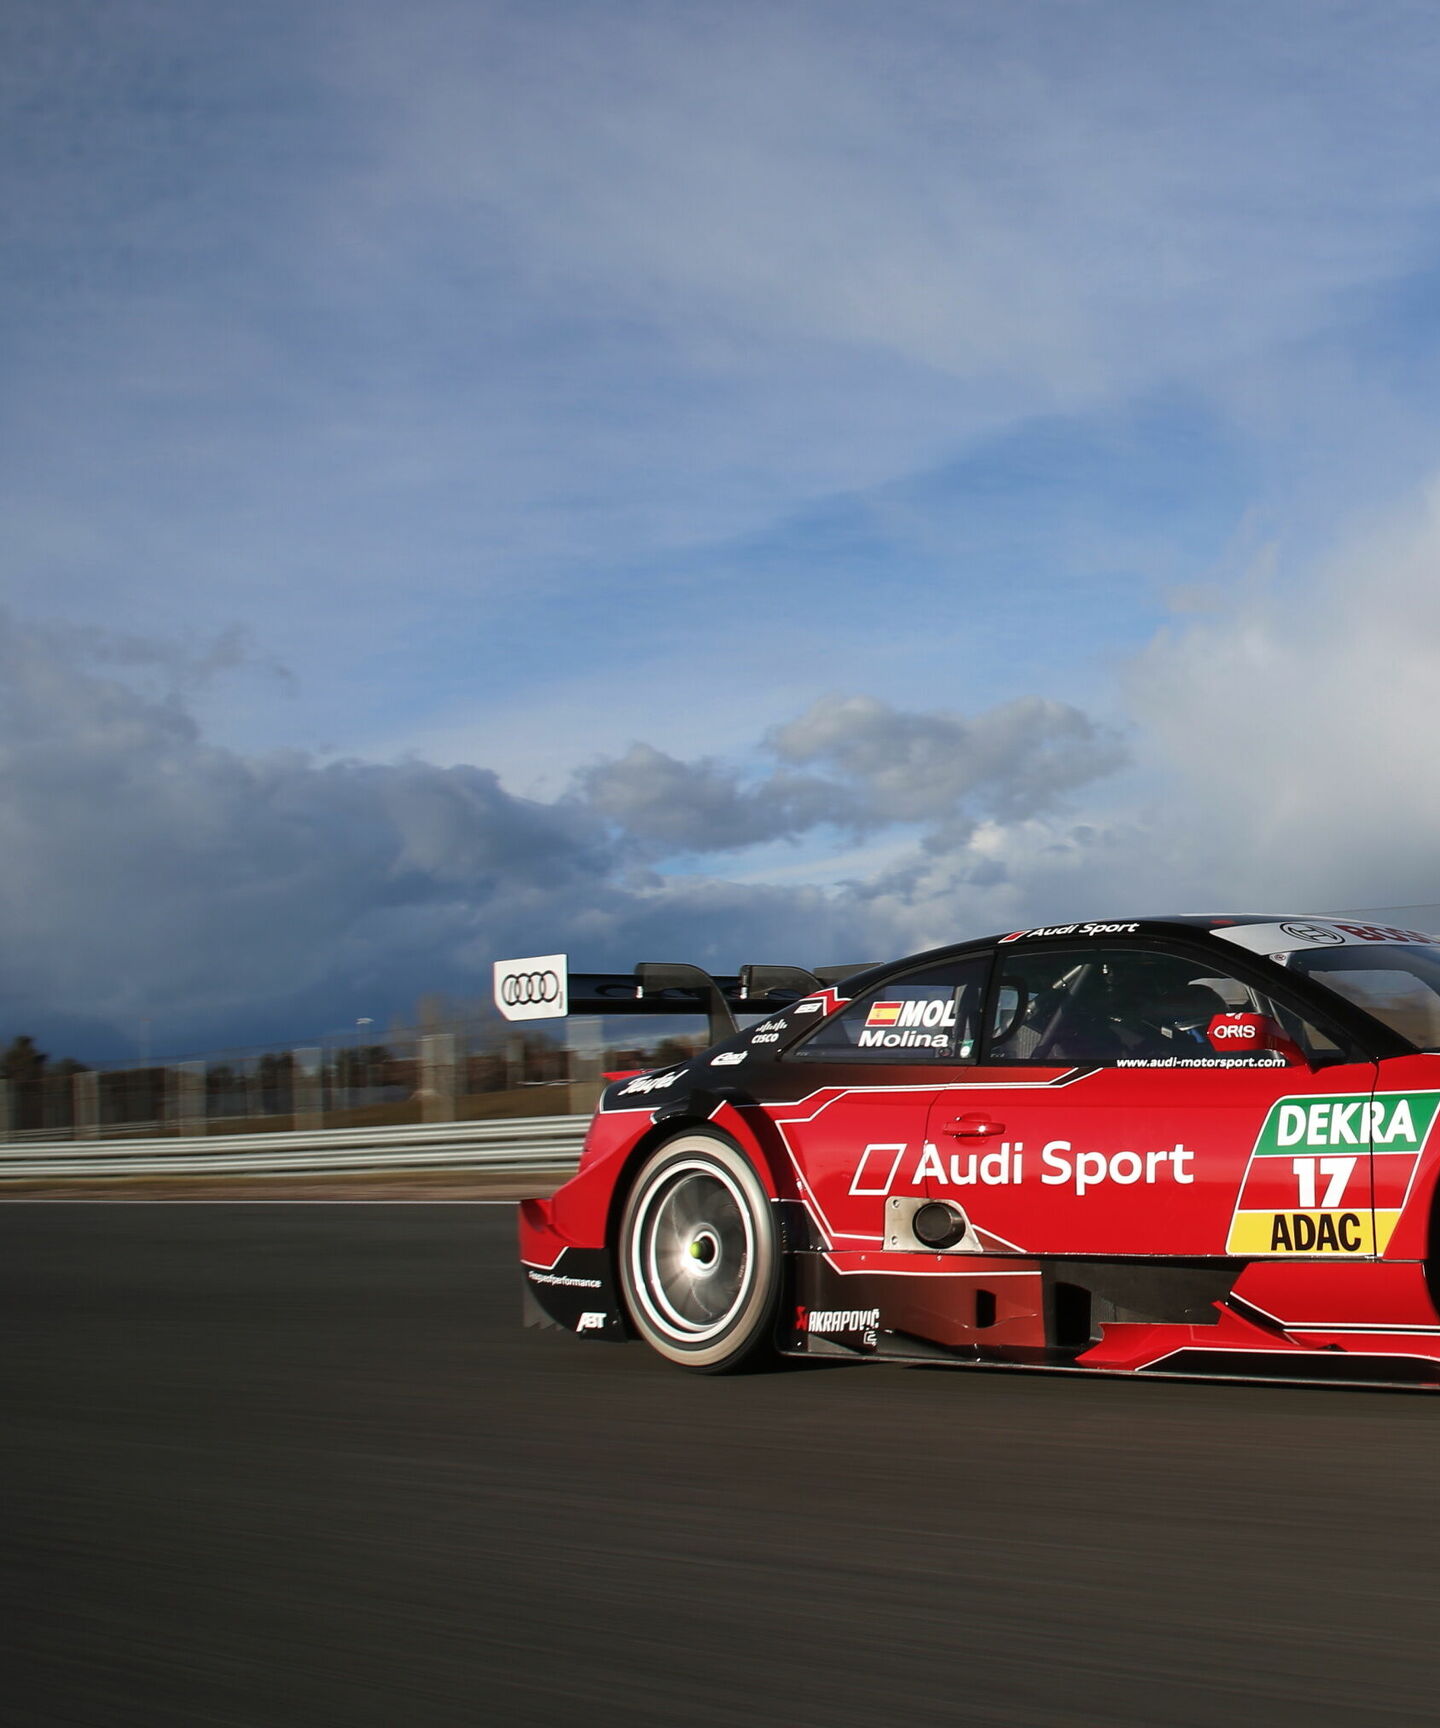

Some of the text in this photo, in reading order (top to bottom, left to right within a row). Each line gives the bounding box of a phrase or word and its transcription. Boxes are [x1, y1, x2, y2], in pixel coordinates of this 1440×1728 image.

[1027, 922, 1140, 938] Audi Sport
[898, 1000, 956, 1027] MOL
[858, 1030, 949, 1048] Molina
[1214, 1025, 1256, 1038] ORIS
[1116, 1056, 1286, 1069] www.audi-motorsport.com
[1276, 1099, 1417, 1147] DEKRA
[911, 1140, 1195, 1196] Audi Sport
[1292, 1157, 1358, 1208] 17
[1270, 1213, 1362, 1251] ADAC
[576, 1312, 608, 1333] ABT
